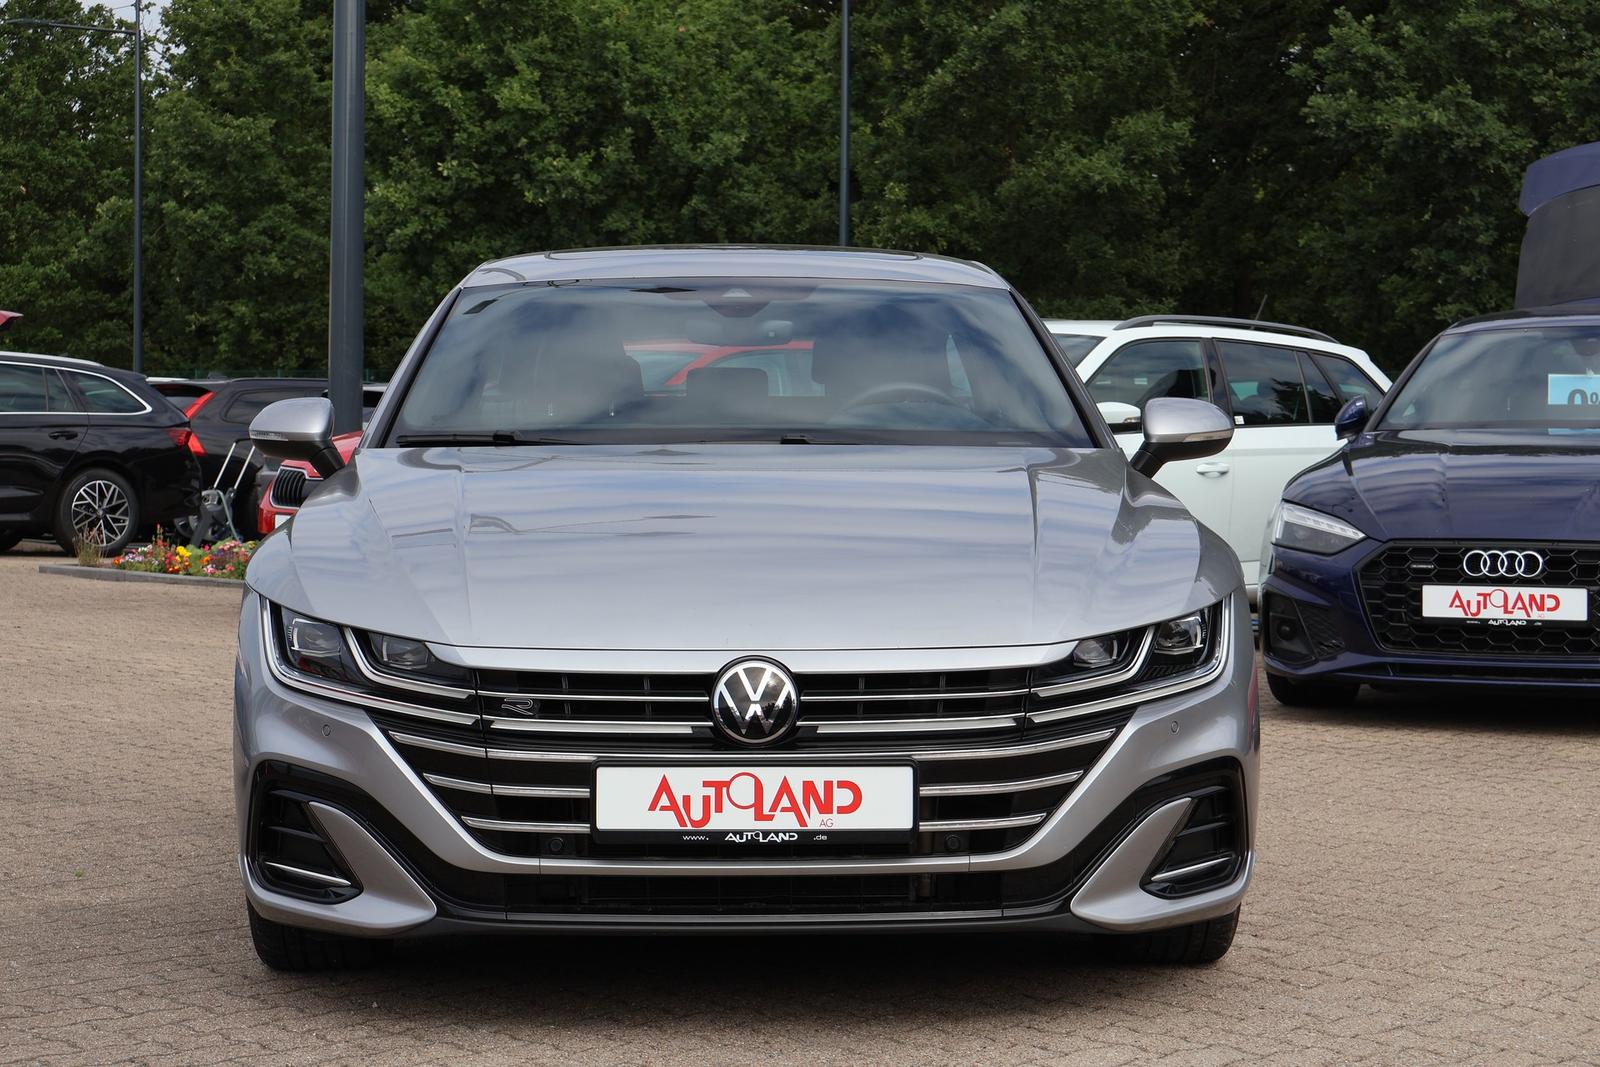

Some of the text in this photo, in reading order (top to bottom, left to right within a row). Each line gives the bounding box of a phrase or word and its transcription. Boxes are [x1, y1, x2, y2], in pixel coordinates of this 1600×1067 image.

[818, 817, 835, 829] AG
[682, 834, 710, 842] www.
[813, 833, 828, 842] .de
